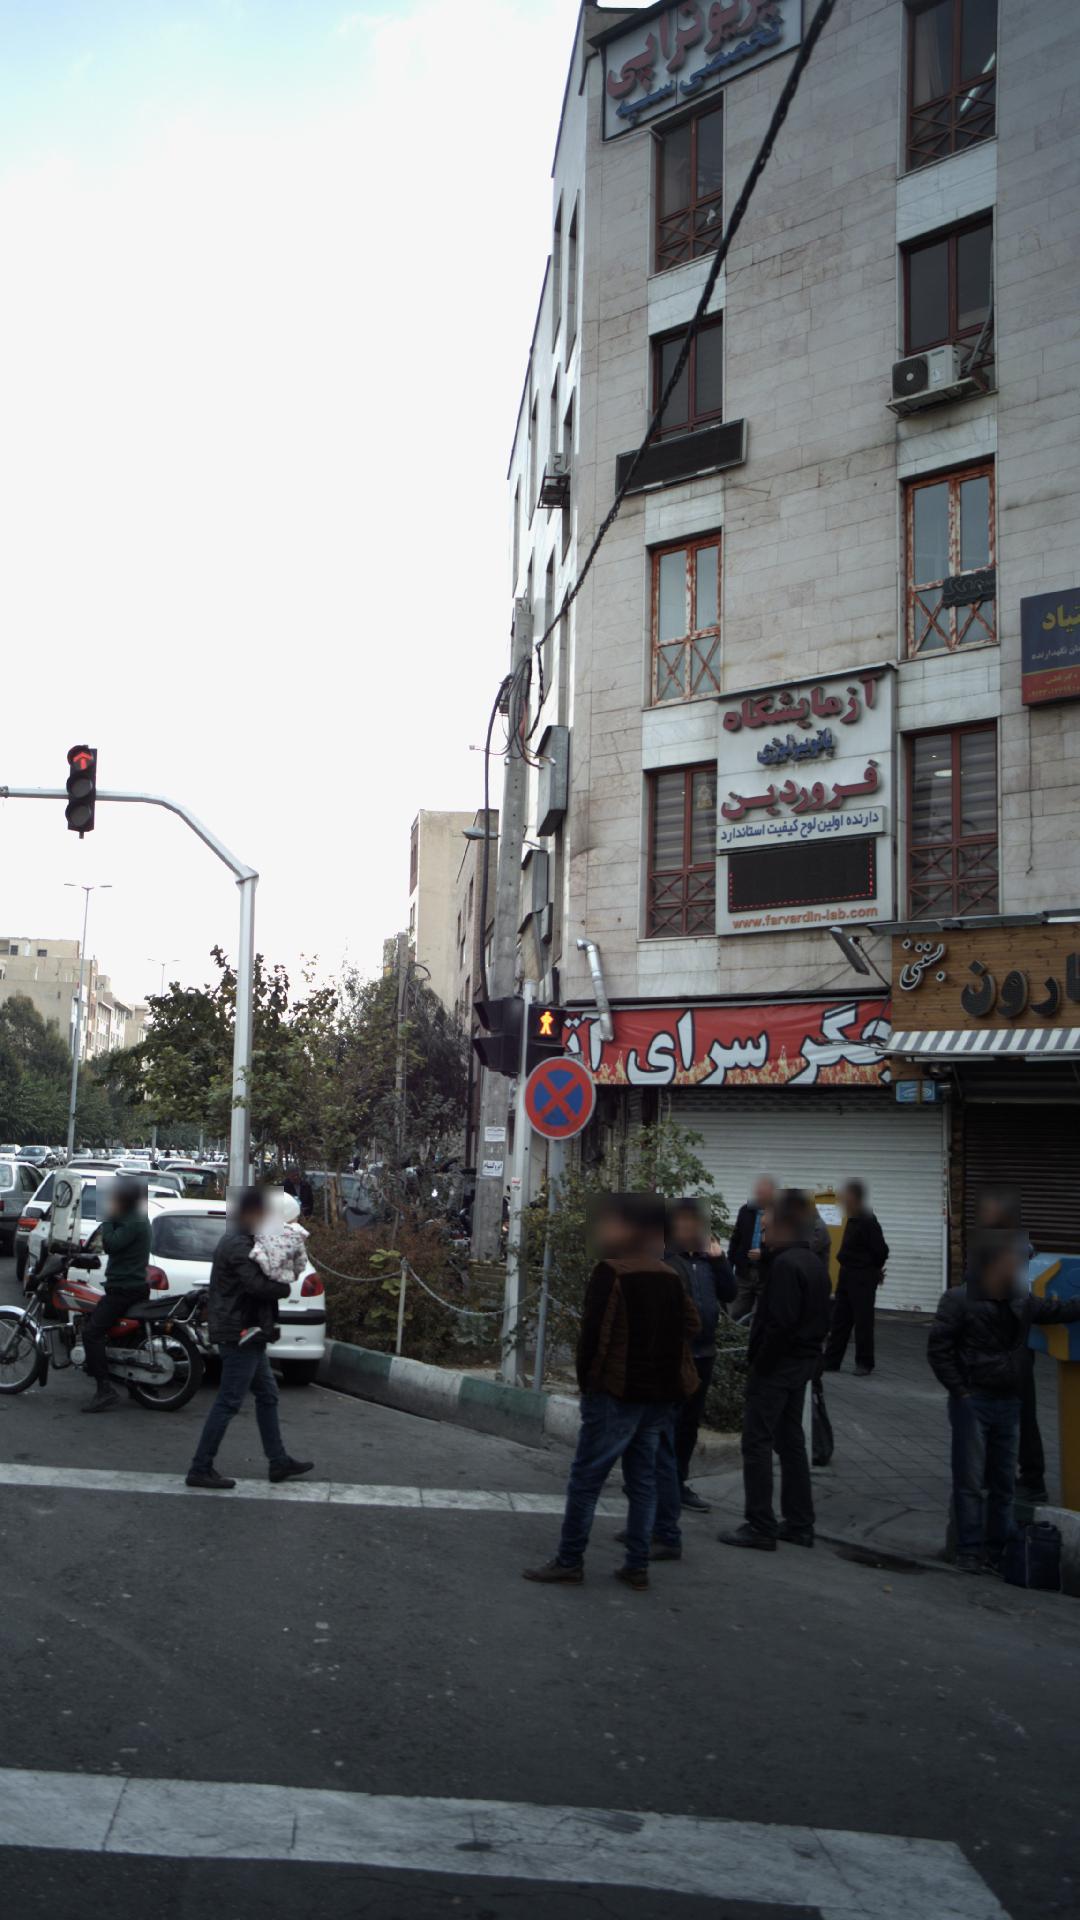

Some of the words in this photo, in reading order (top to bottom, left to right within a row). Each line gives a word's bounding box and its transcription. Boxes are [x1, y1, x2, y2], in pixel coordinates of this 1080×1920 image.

[723, 671, 884, 731] آزمایشگاه
[721, 760, 882, 820] فروردین
[768, 819, 799, 837] کیفیت
[800, 817, 817, 838] لوح
[817, 813, 844, 833] اولین
[846, 811, 880, 826] دارنده
[720, 822, 766, 843] استاندارد
[732, 907, 879, 930] www.farvardin-lab.com
[899, 938, 947, 991] بستنی
